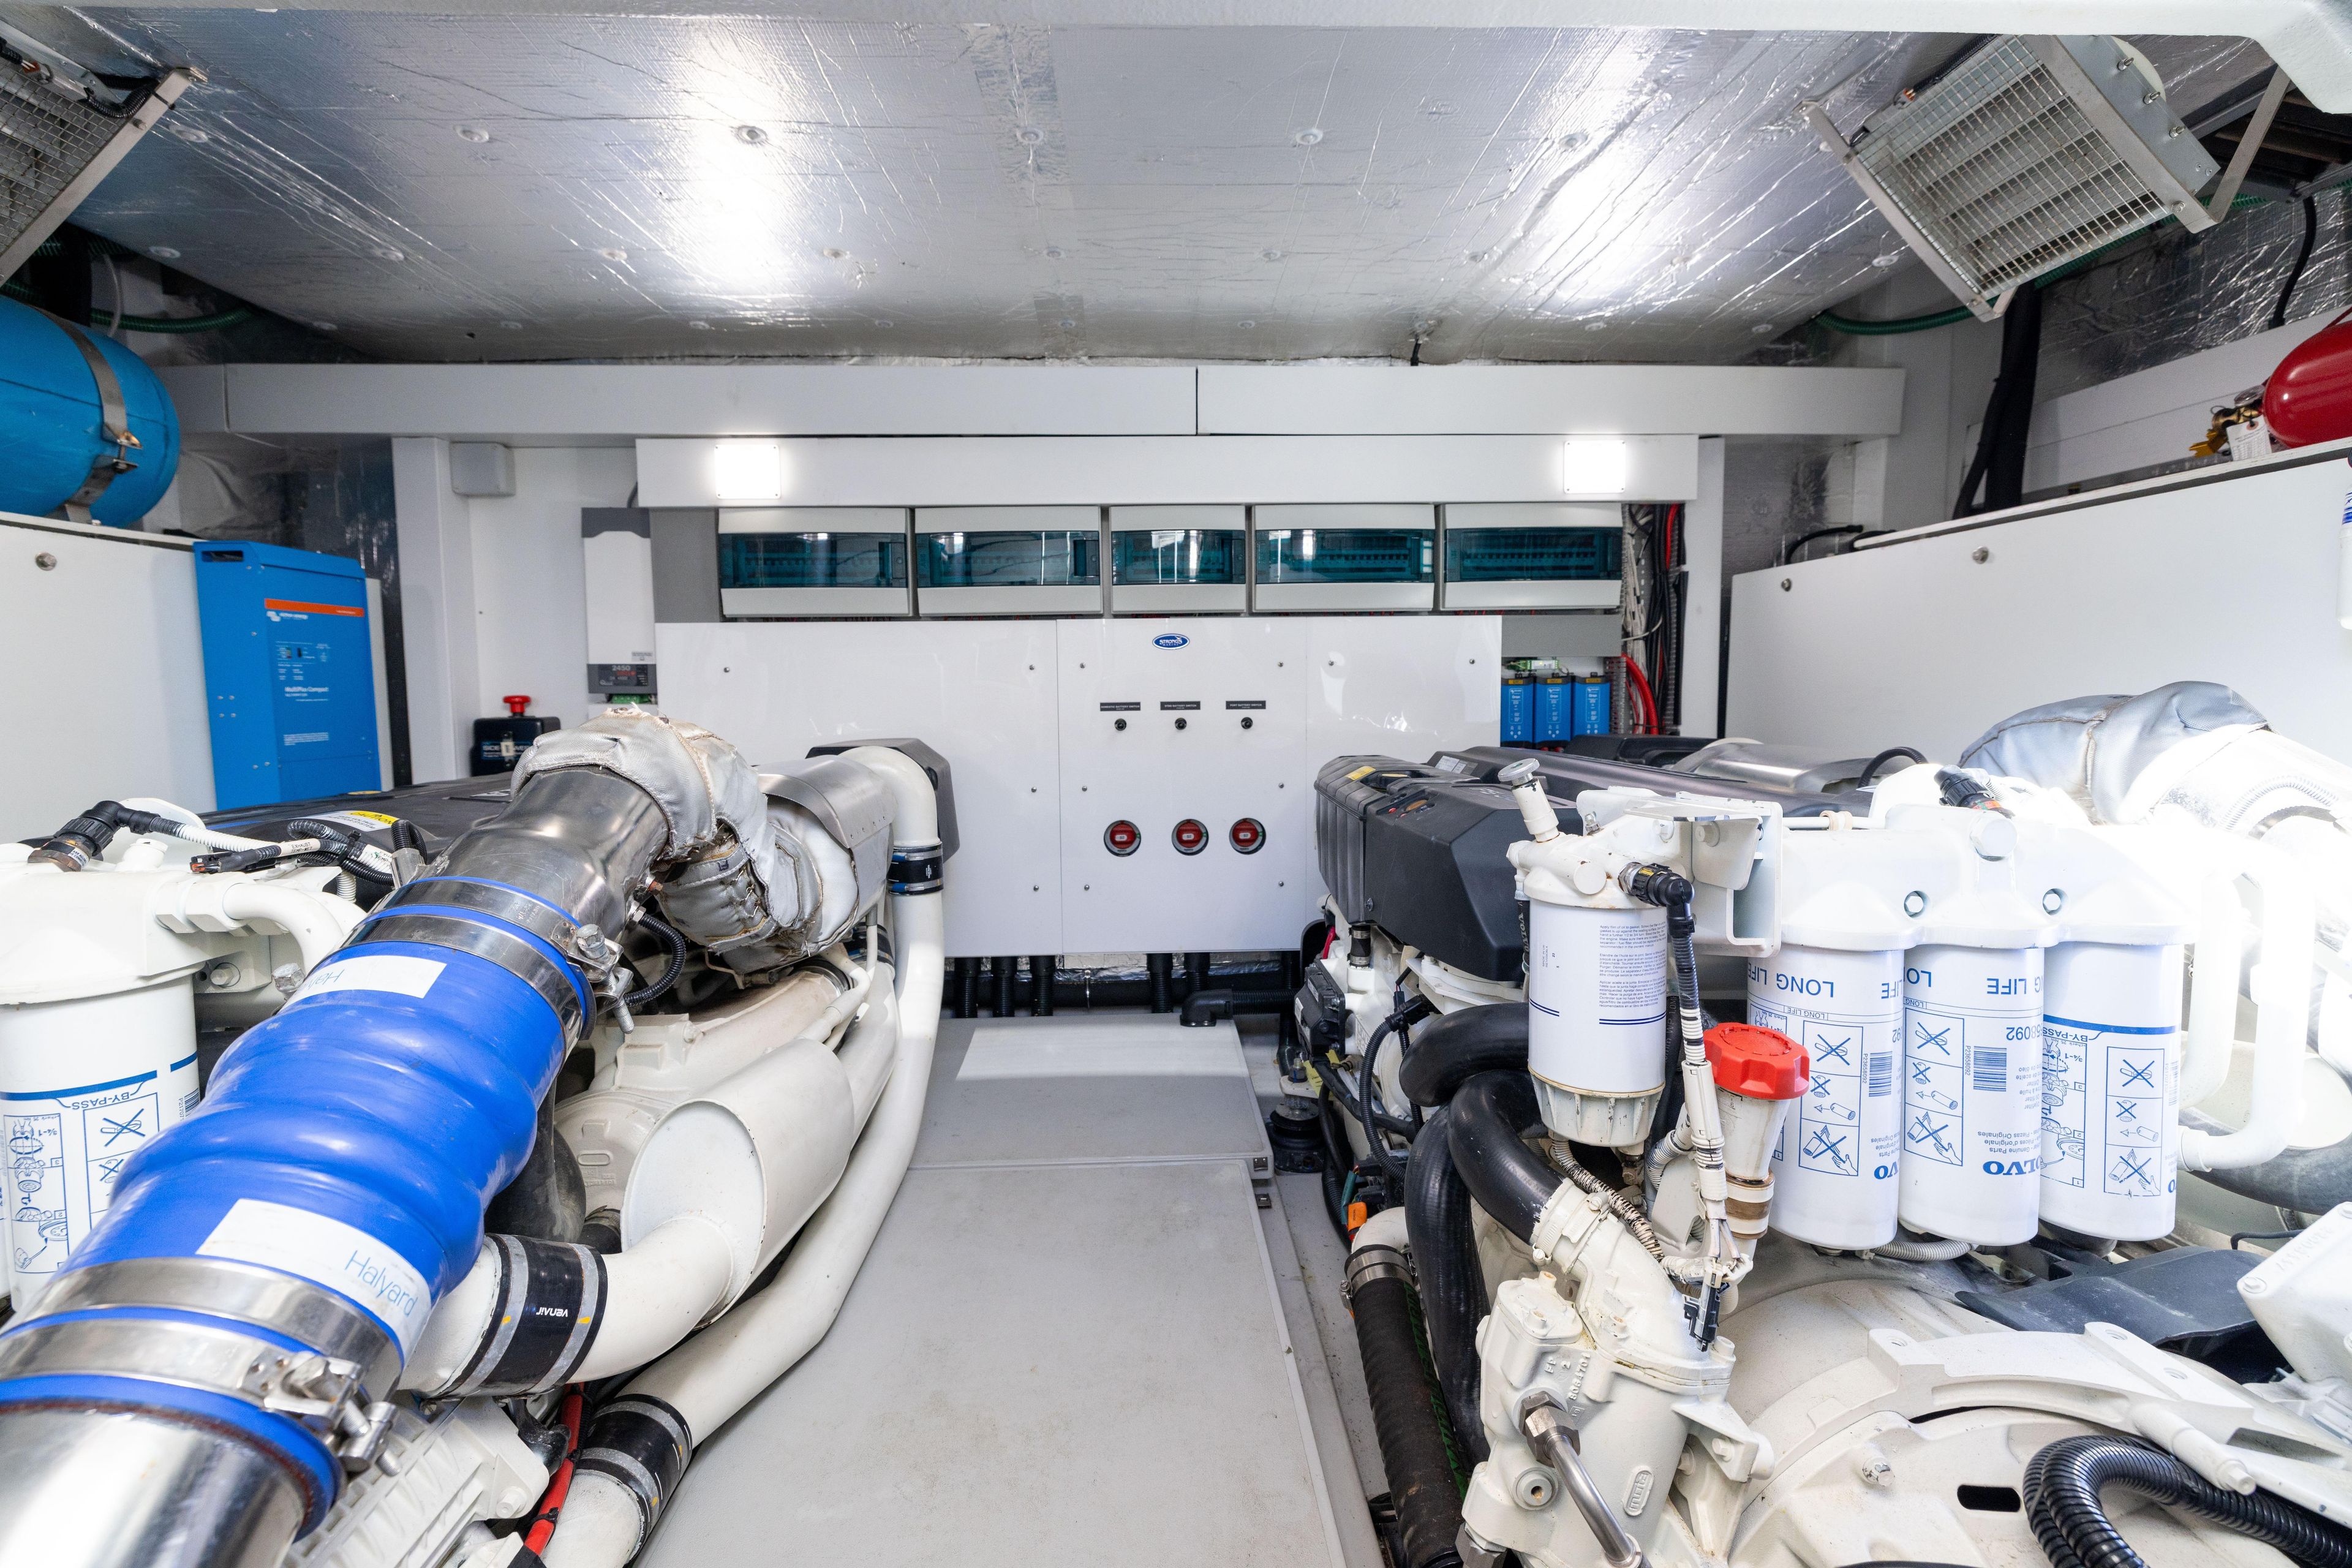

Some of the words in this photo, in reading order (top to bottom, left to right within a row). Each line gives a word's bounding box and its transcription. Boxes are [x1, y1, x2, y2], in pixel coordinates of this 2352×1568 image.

[1748, 962, 1767, 985] LIFE
[1776, 973, 1834, 998] LONG
[1904, 968, 1932, 987] LO
[1882, 979, 1902, 999] LIFE
[1987, 978, 2027, 995] LIFE
[1905, 998, 1924, 1008] LONG
[2006, 1026, 2043, 1041] 58092
[2043, 1027, 2087, 1042] BY-PASS
[71, 1092, 130, 1110] BY-PASS
[1871, 1134, 1894, 1143] Originales
[344, 1250, 418, 1317] Halyard
[535, 1306, 568, 1318] venair
